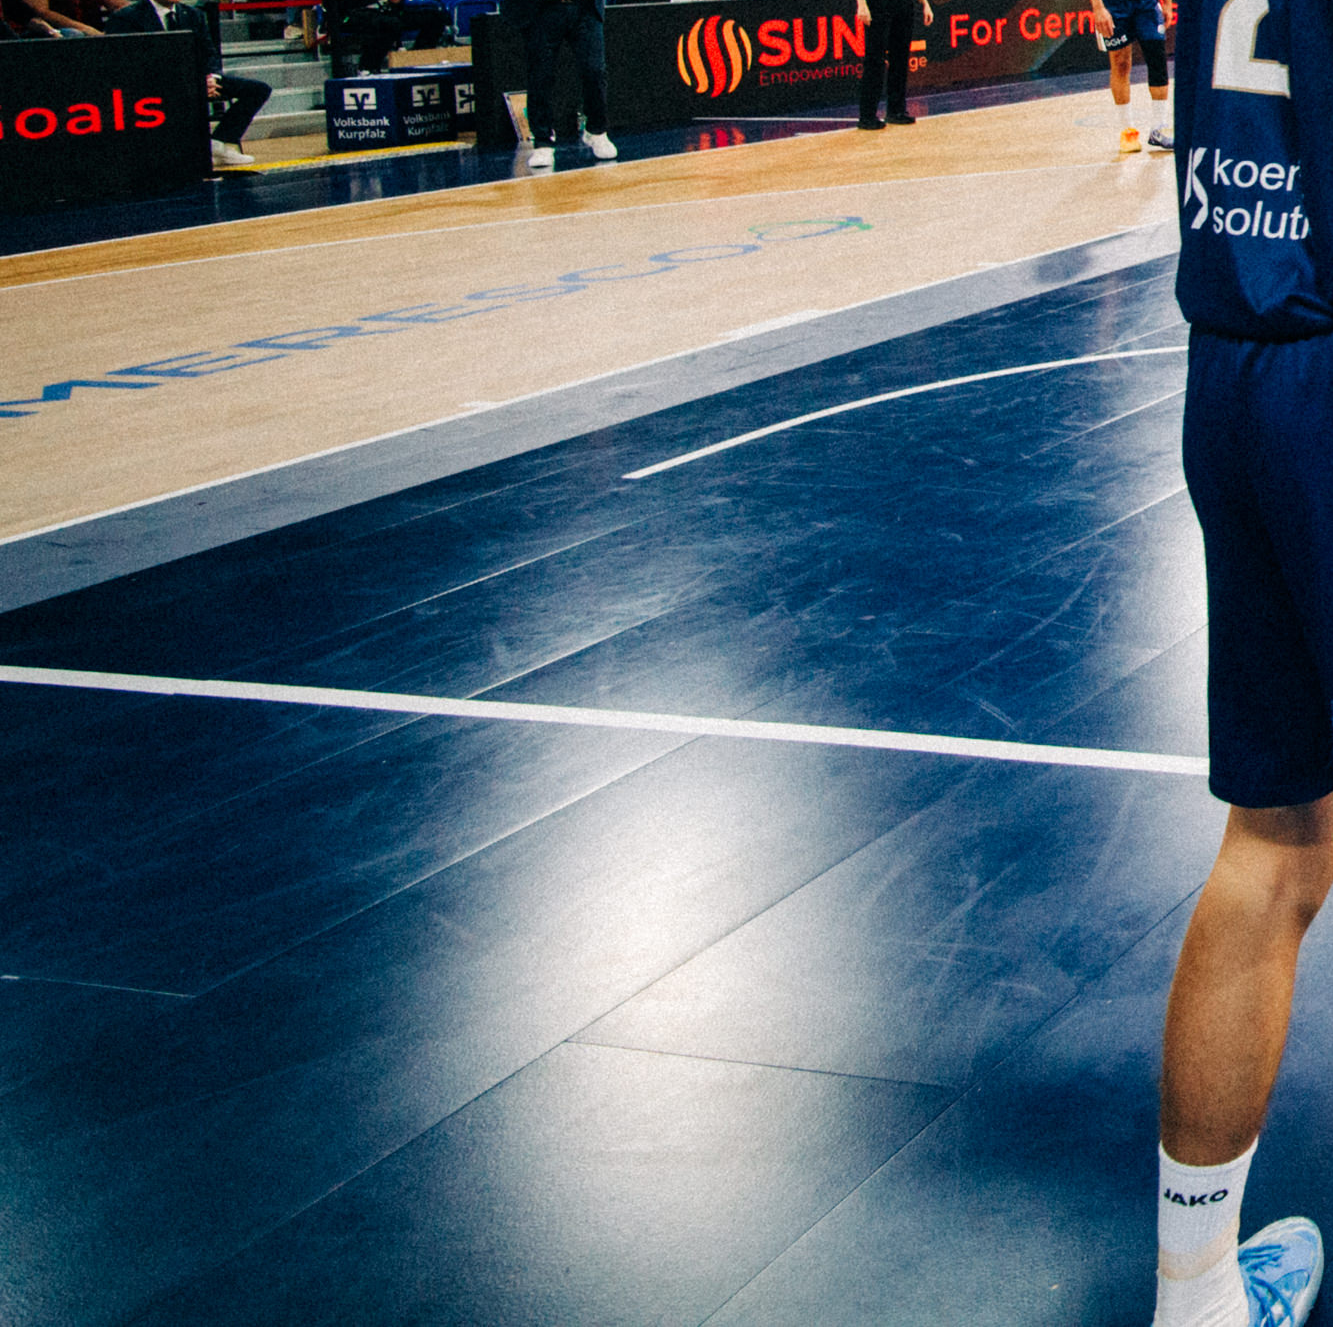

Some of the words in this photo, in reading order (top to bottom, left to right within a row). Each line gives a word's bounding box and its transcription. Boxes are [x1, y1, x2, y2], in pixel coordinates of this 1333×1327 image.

[950, 13, 1008, 49] For
[758, 60, 865, 87] Empowering
[0, 88, 166, 140] oals
[333, 115, 391, 127] Volksbank
[338, 128, 387, 141] Kurpfalz
